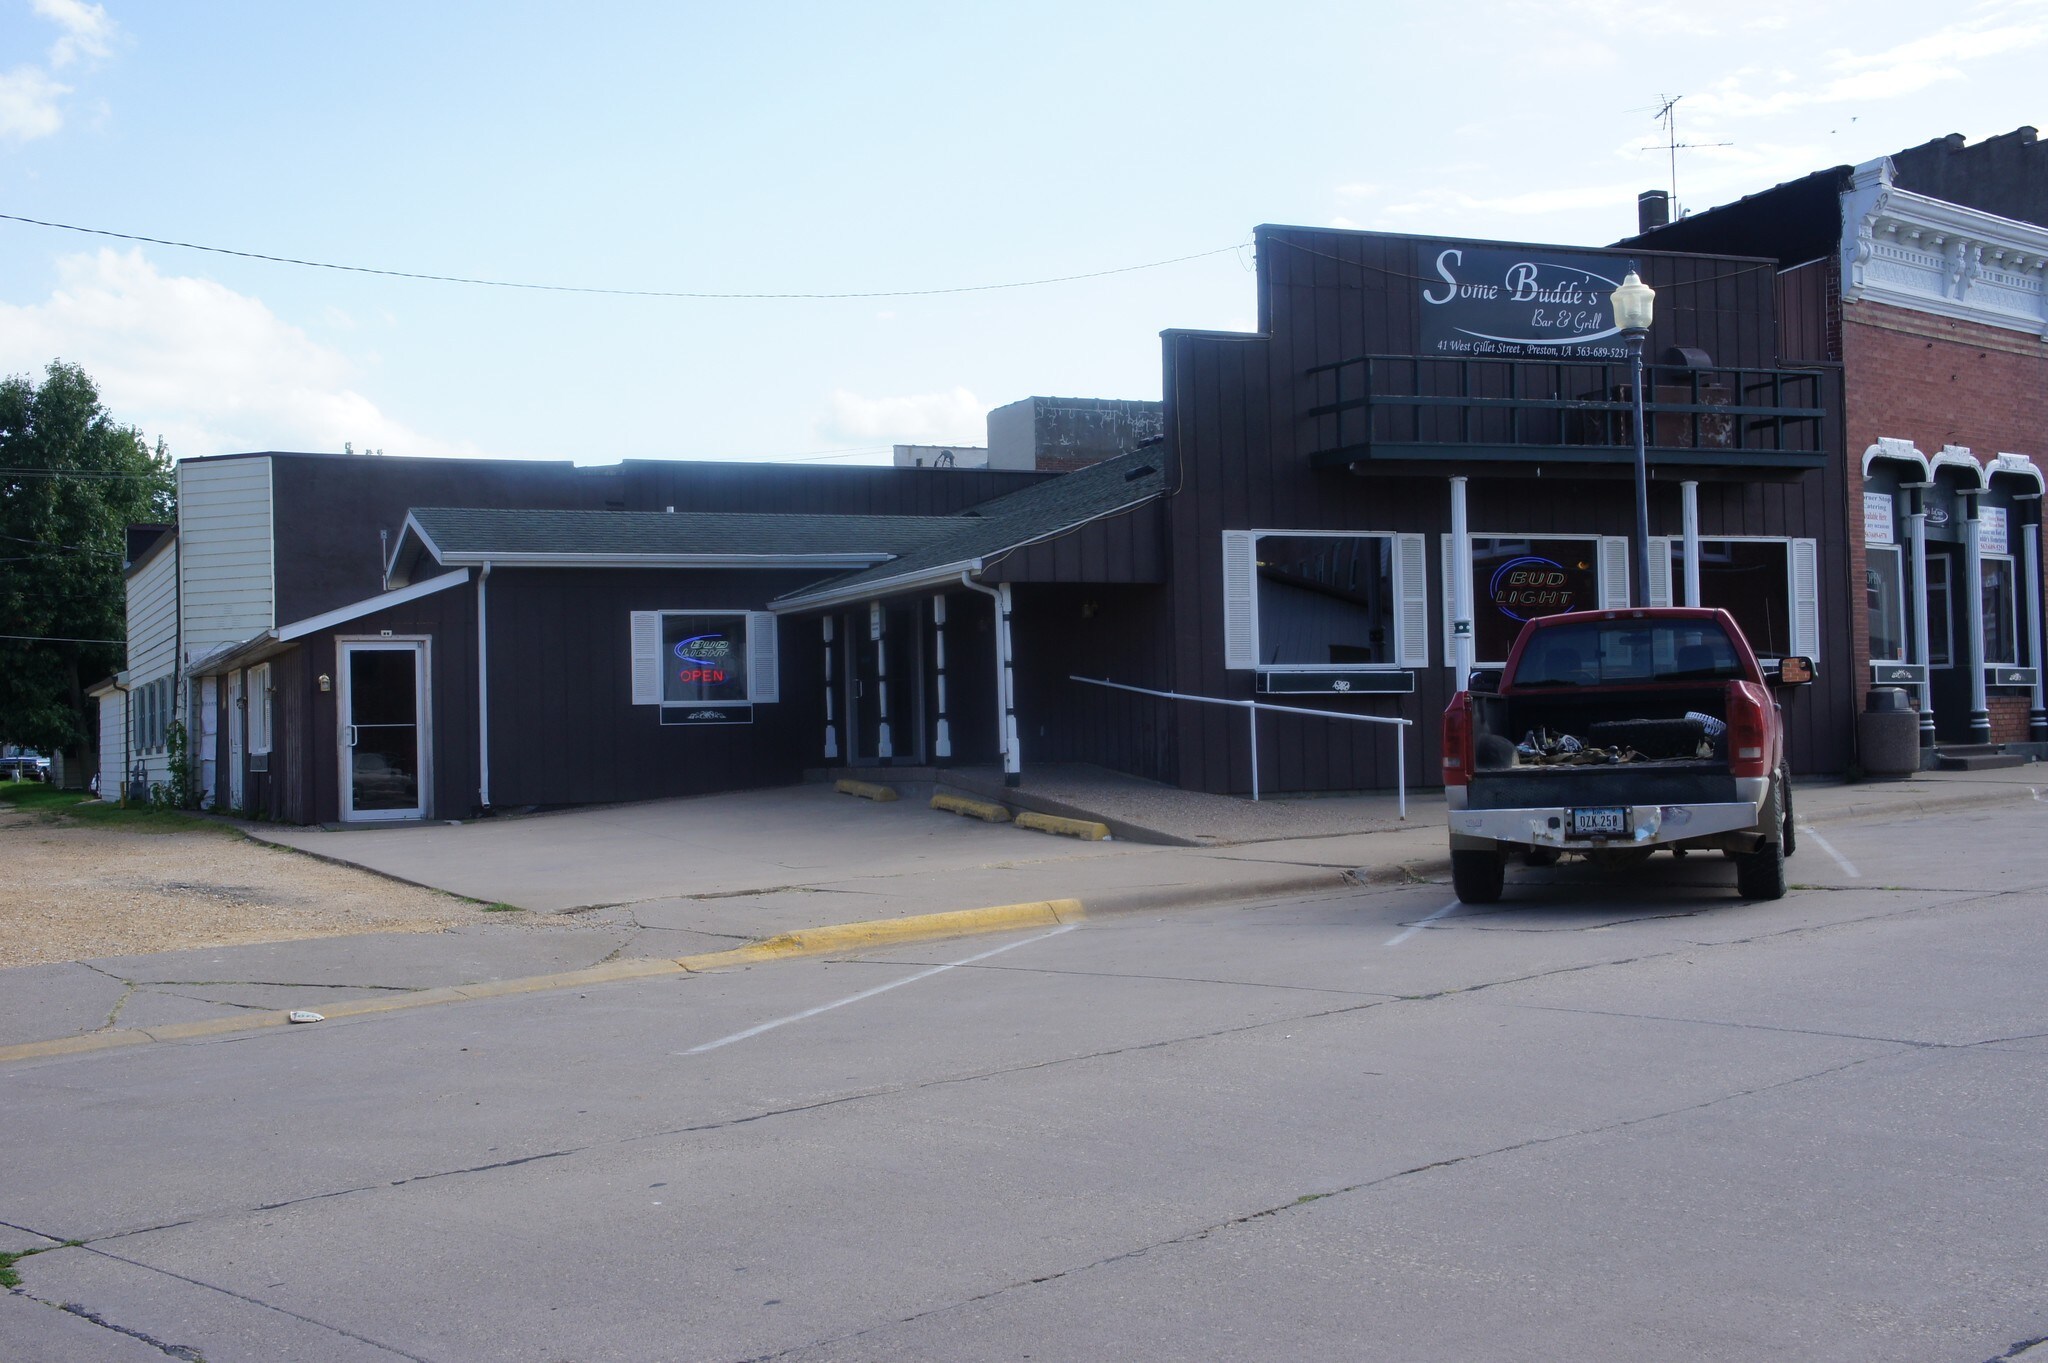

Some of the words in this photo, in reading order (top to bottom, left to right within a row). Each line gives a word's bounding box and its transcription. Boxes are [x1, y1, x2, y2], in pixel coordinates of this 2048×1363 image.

[1423, 249, 1498, 304] Some
[1505, 262, 1598, 305] Budde's
[1531, 308, 1553, 327] Bar
[1556, 309, 1572, 328] &
[1573, 311, 1602, 334] Grill
[1437, 340, 1447, 351] 41
[1449, 339, 1471, 352] West
[1473, 341, 1495, 356] Gillet
[1526, 344, 1559, 357] Preston,
[1560, 345, 1572, 357] IA
[1576, 346, 1629, 359] 563-689-5251
[1509, 571, 1565, 586] BUD
[1496, 590, 1573, 604] LIGHT
[690, 640, 729, 648] BUD
[681, 648, 729, 656] LIGHT
[680, 669, 724, 682] OPEN
